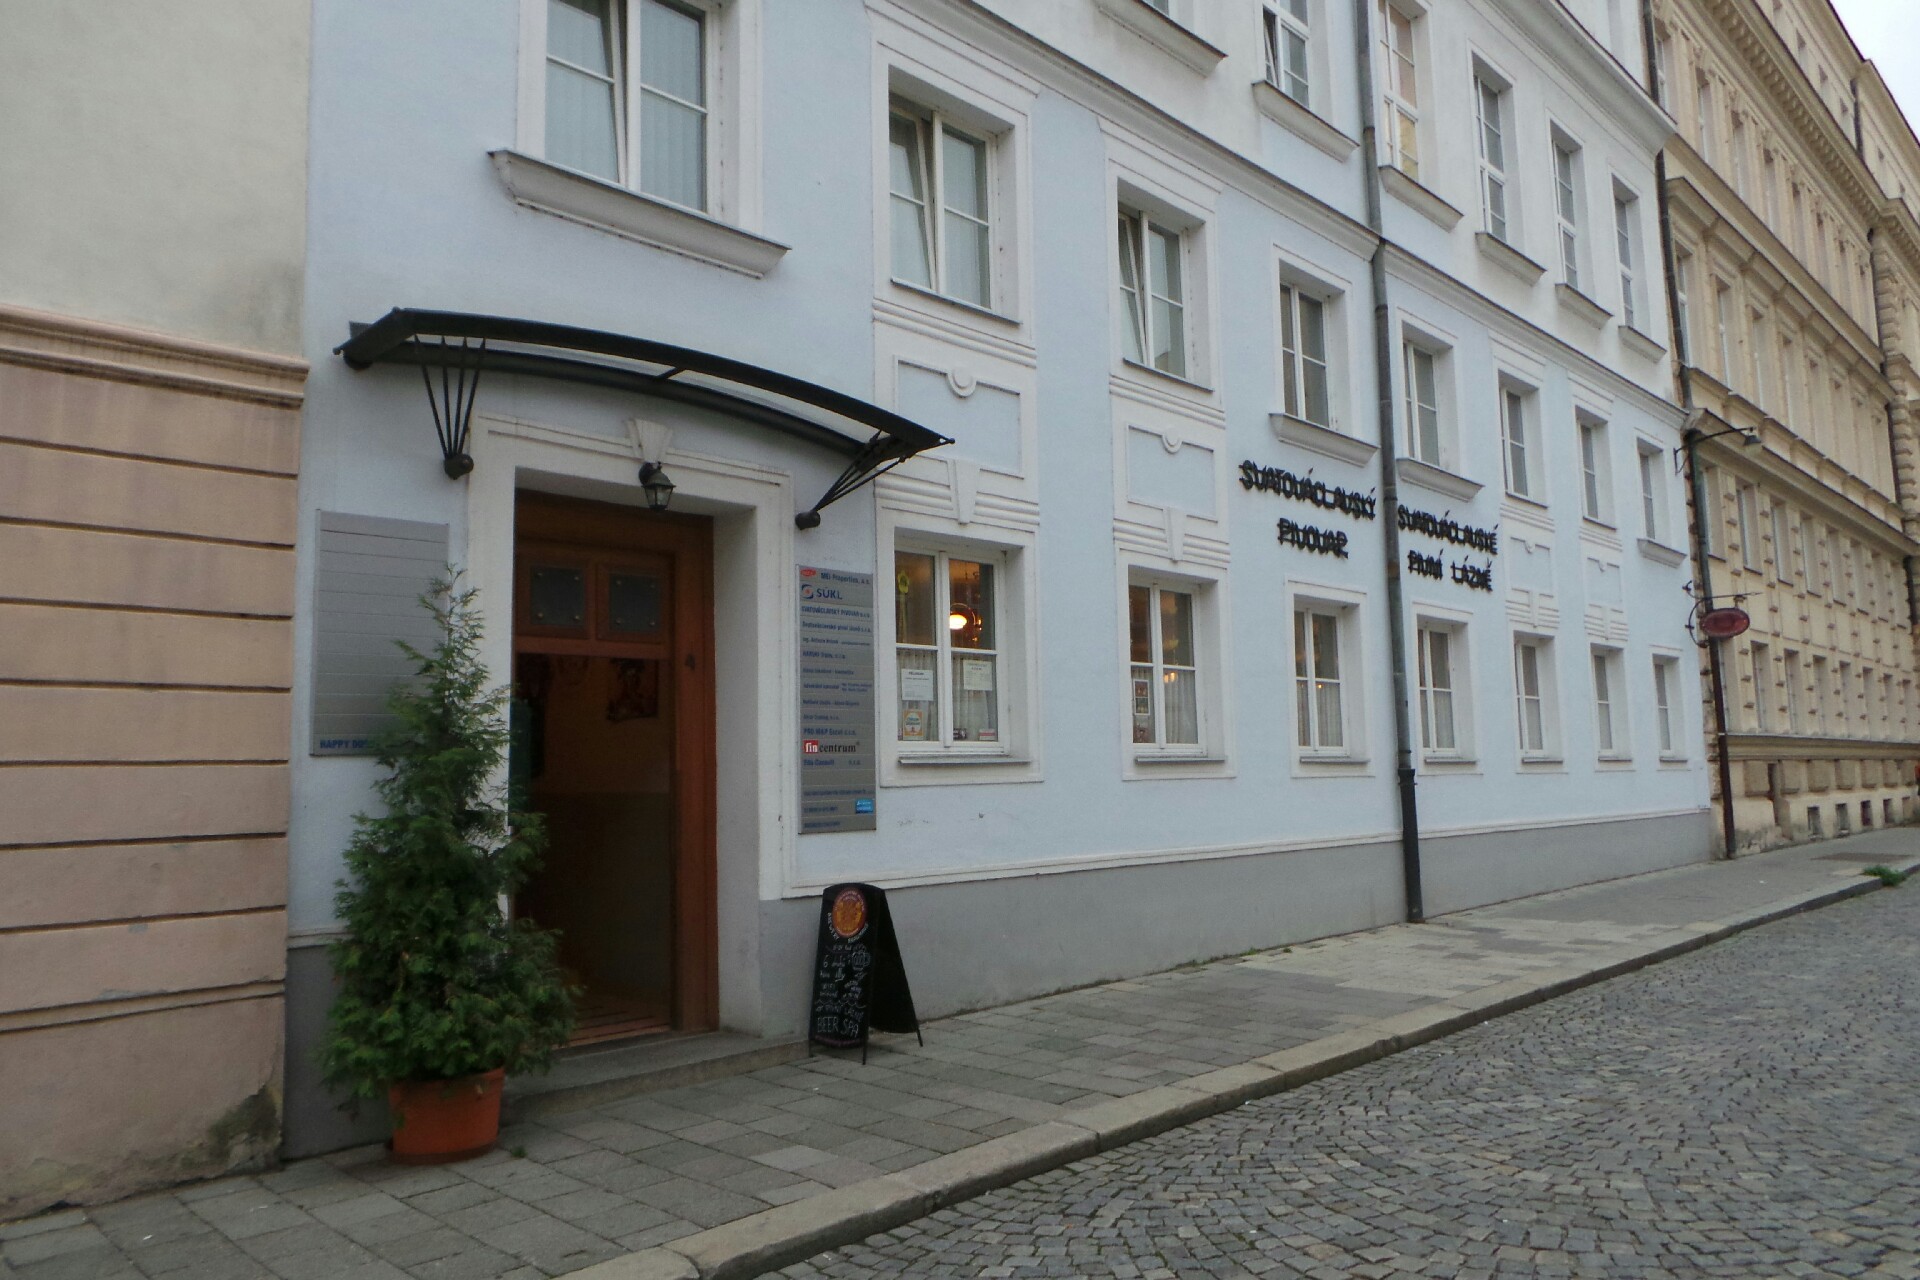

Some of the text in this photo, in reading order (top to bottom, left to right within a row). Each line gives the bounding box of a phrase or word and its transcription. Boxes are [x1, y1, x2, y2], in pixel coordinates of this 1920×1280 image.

[1277, 518, 1348, 559] PIVOVAR
[1407, 548, 1493, 592] PIVNÍ LÁZNĚ
[817, 1016, 859, 1038] BEER SPA
